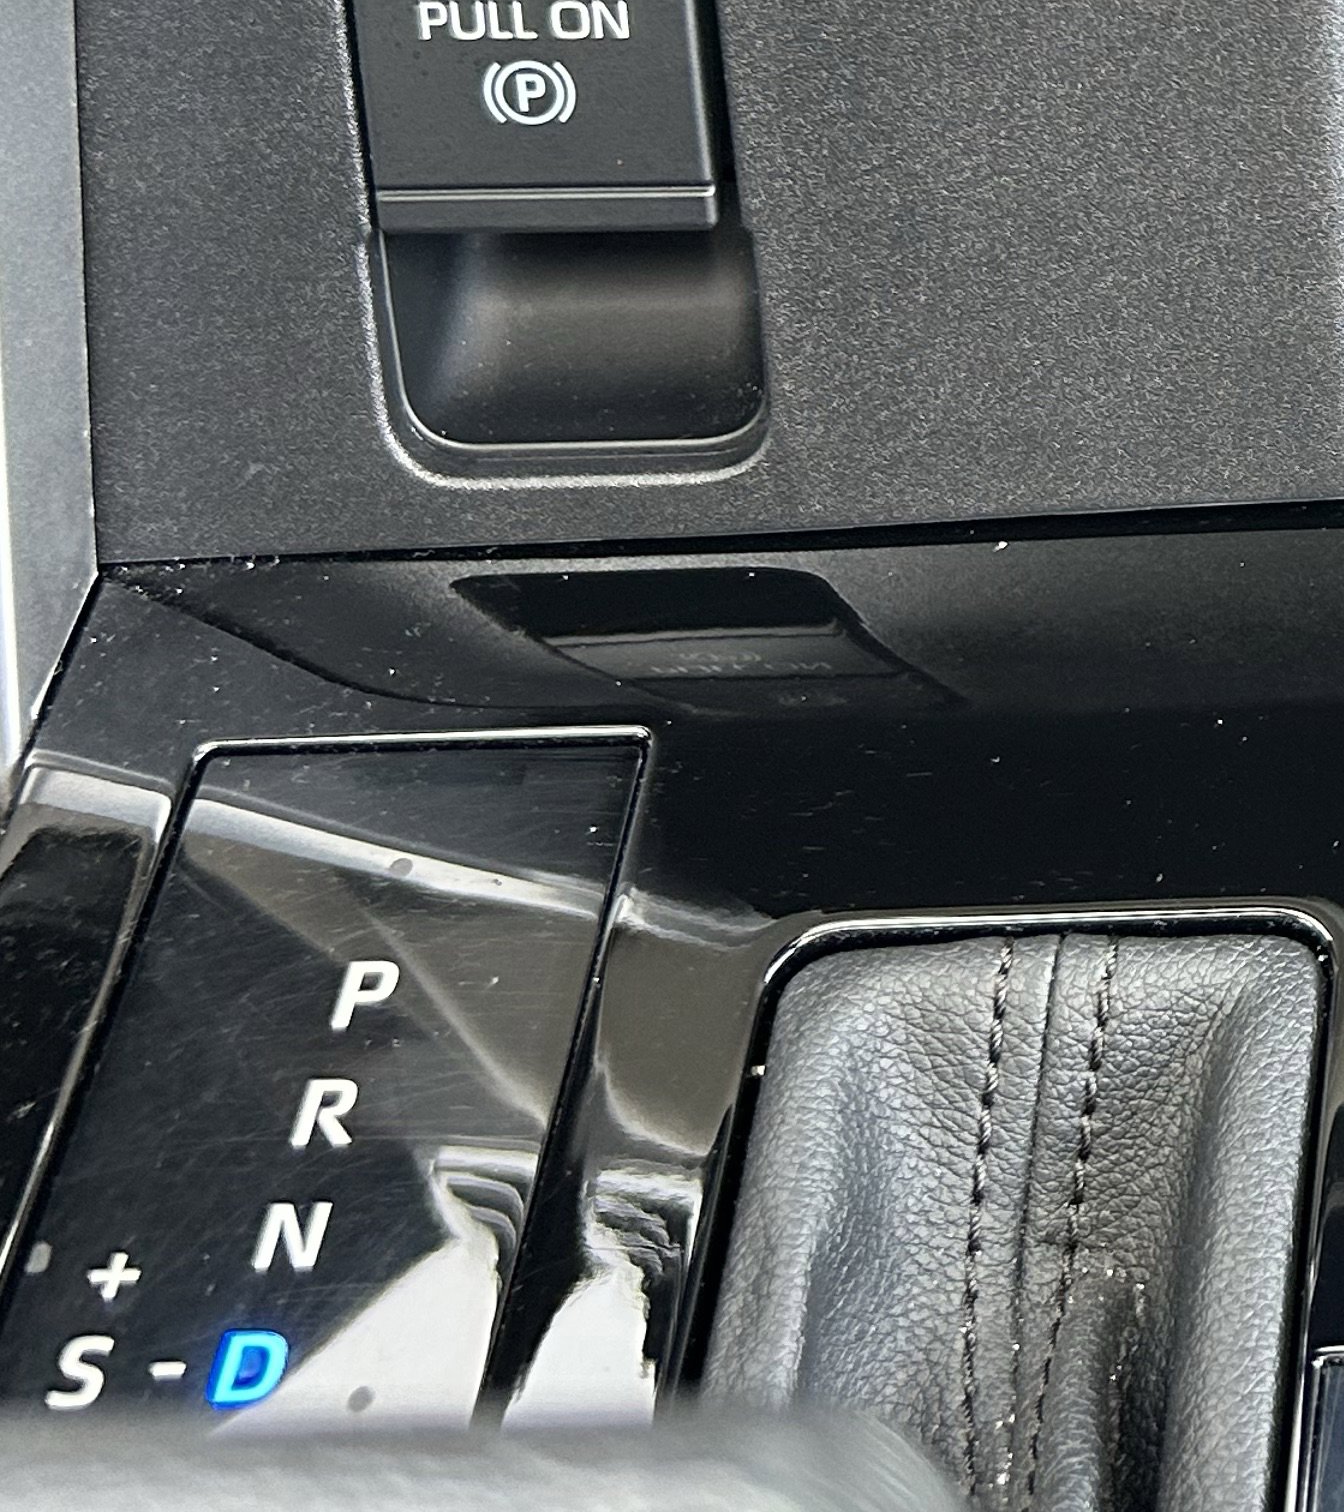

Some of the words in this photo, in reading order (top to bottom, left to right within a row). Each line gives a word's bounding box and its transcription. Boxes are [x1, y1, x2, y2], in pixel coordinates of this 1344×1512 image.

[416, 0, 538, 41] PULL
[550, 0, 630, 40] ON
[331, 960, 400, 1030] P
[289, 1078, 359, 1148] R
[251, 1202, 333, 1272] N
[45, 1334, 115, 1410] S
[205, 1328, 290, 1411] D
